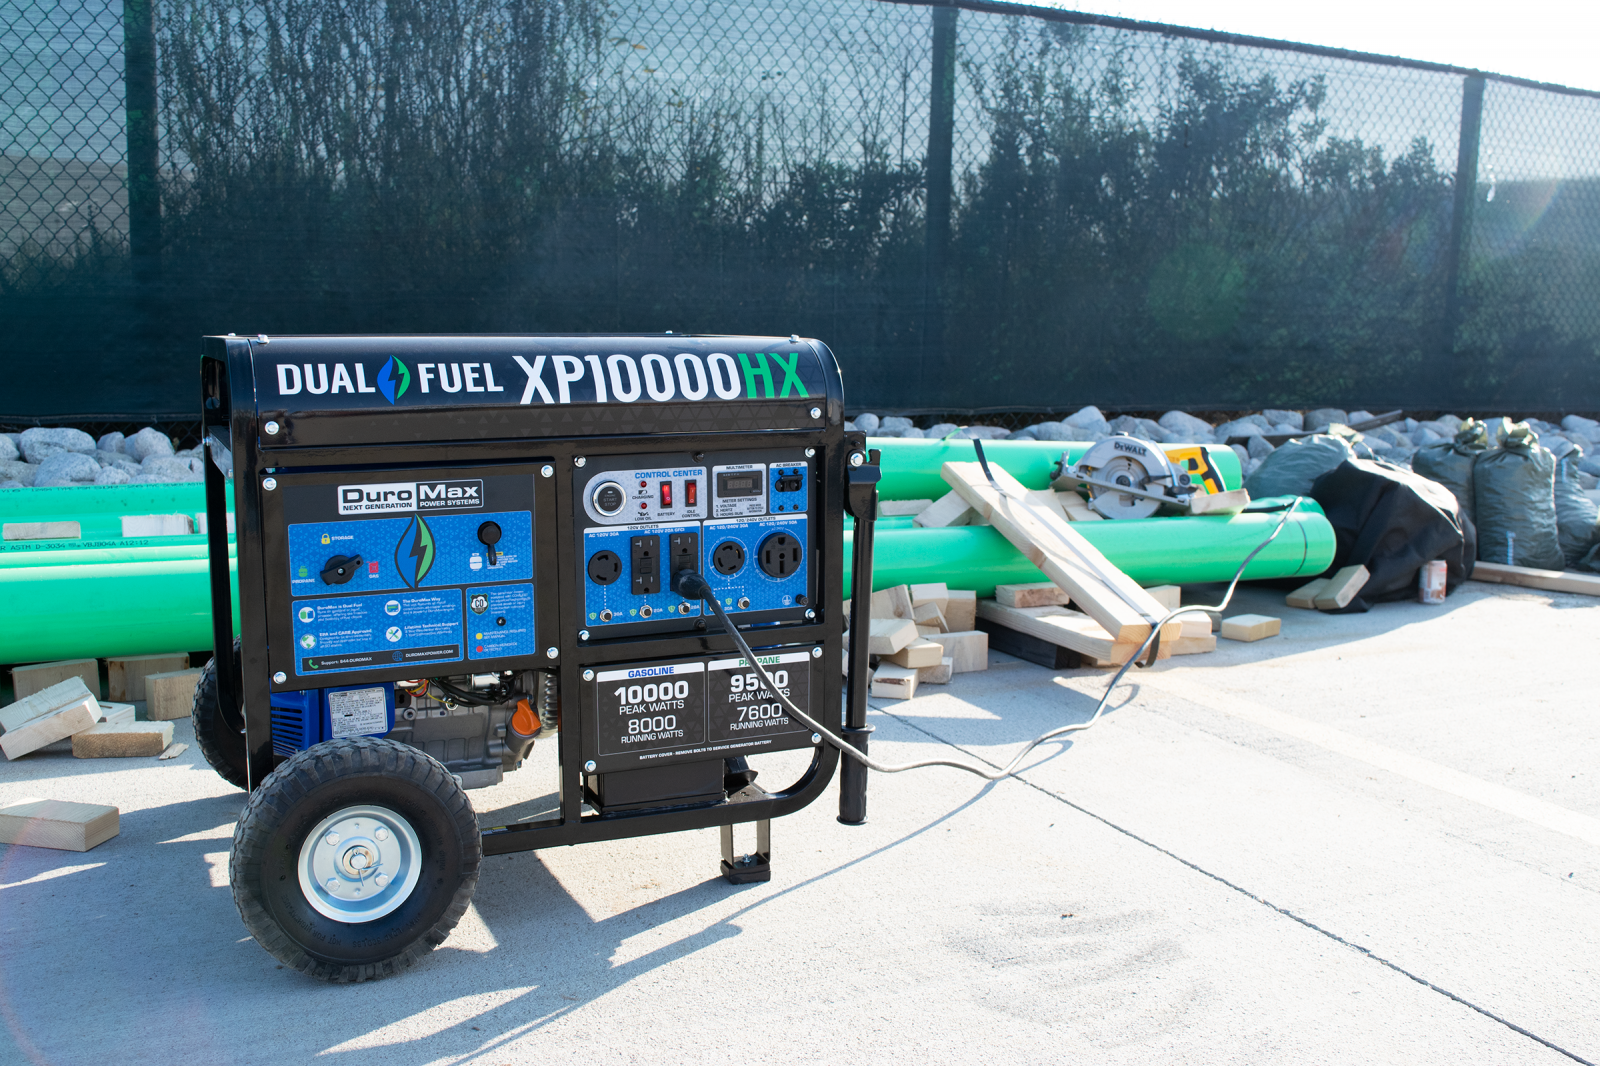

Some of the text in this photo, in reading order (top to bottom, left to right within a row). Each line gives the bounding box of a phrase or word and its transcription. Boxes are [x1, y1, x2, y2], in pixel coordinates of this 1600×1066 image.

[276, 352, 810, 404] DUAL FUEL XP10000HX
[635, 469, 703, 479] CONTROL CENTER
[365, 502, 412, 510] GENERATION
[475, 599, 485, 608] CO
[738, 656, 781, 667] PRPANE
[628, 666, 674, 678] GASOLINE
[614, 680, 689, 705] 10000
[728, 688, 790, 703] PEAK WAS
[619, 700, 685, 715] PEAK WATTS
[736, 702, 783, 721] 7600
[628, 714, 676, 734] 8000
[730, 717, 789, 731] RUNNING WATTS
[621, 729, 684, 744] RUNNING WATTS
